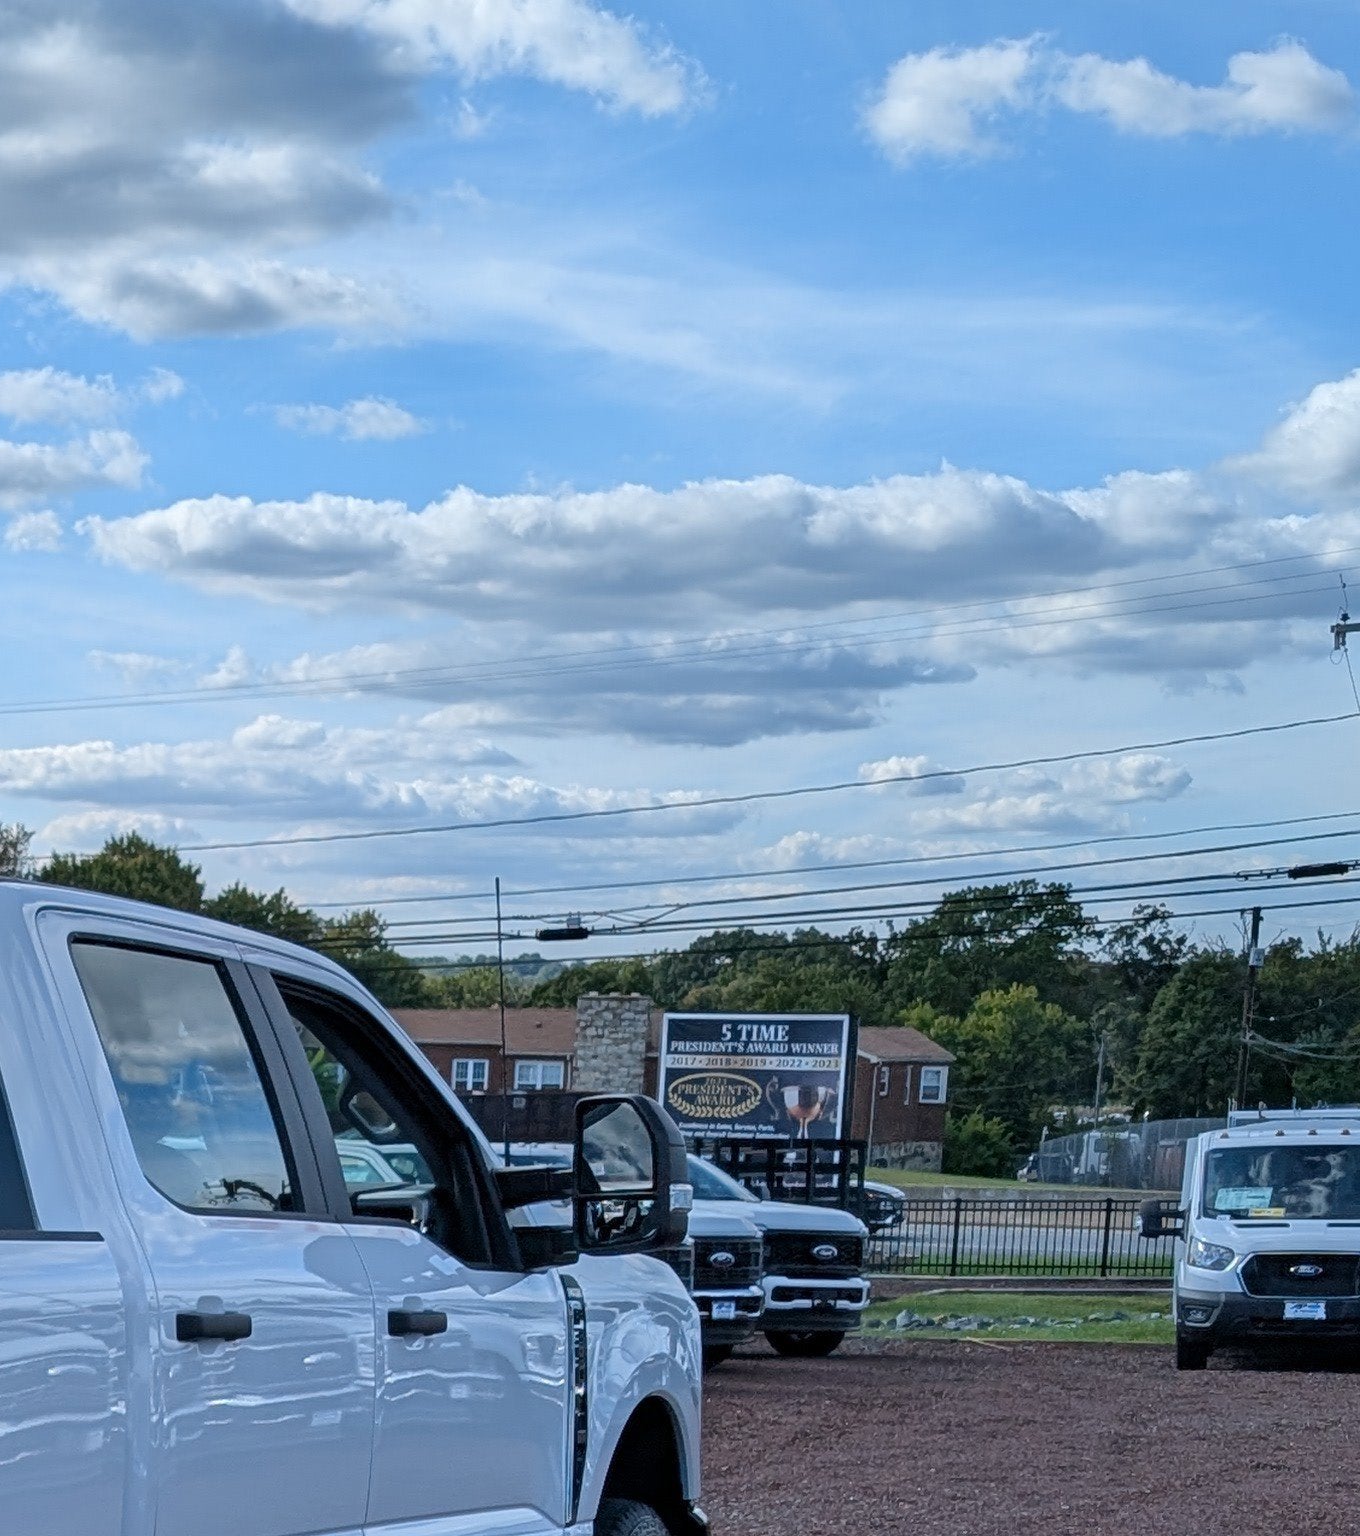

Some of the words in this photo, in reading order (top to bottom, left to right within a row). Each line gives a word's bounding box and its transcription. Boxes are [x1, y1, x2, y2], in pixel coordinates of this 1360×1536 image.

[721, 1023, 732, 1041] 5
[737, 1024, 790, 1042] TIME
[670, 1040, 745, 1053] PRESIDENT'S
[745, 1041, 789, 1054] AWARD
[791, 1042, 839, 1055] WINNER
[671, 1056, 697, 1066] 2017
[705, 1057, 732, 1067] 2018
[739, 1058, 767, 1067] 2019
[776, 1058, 803, 1068] 2022
[811, 1059, 839, 1068] 2023
